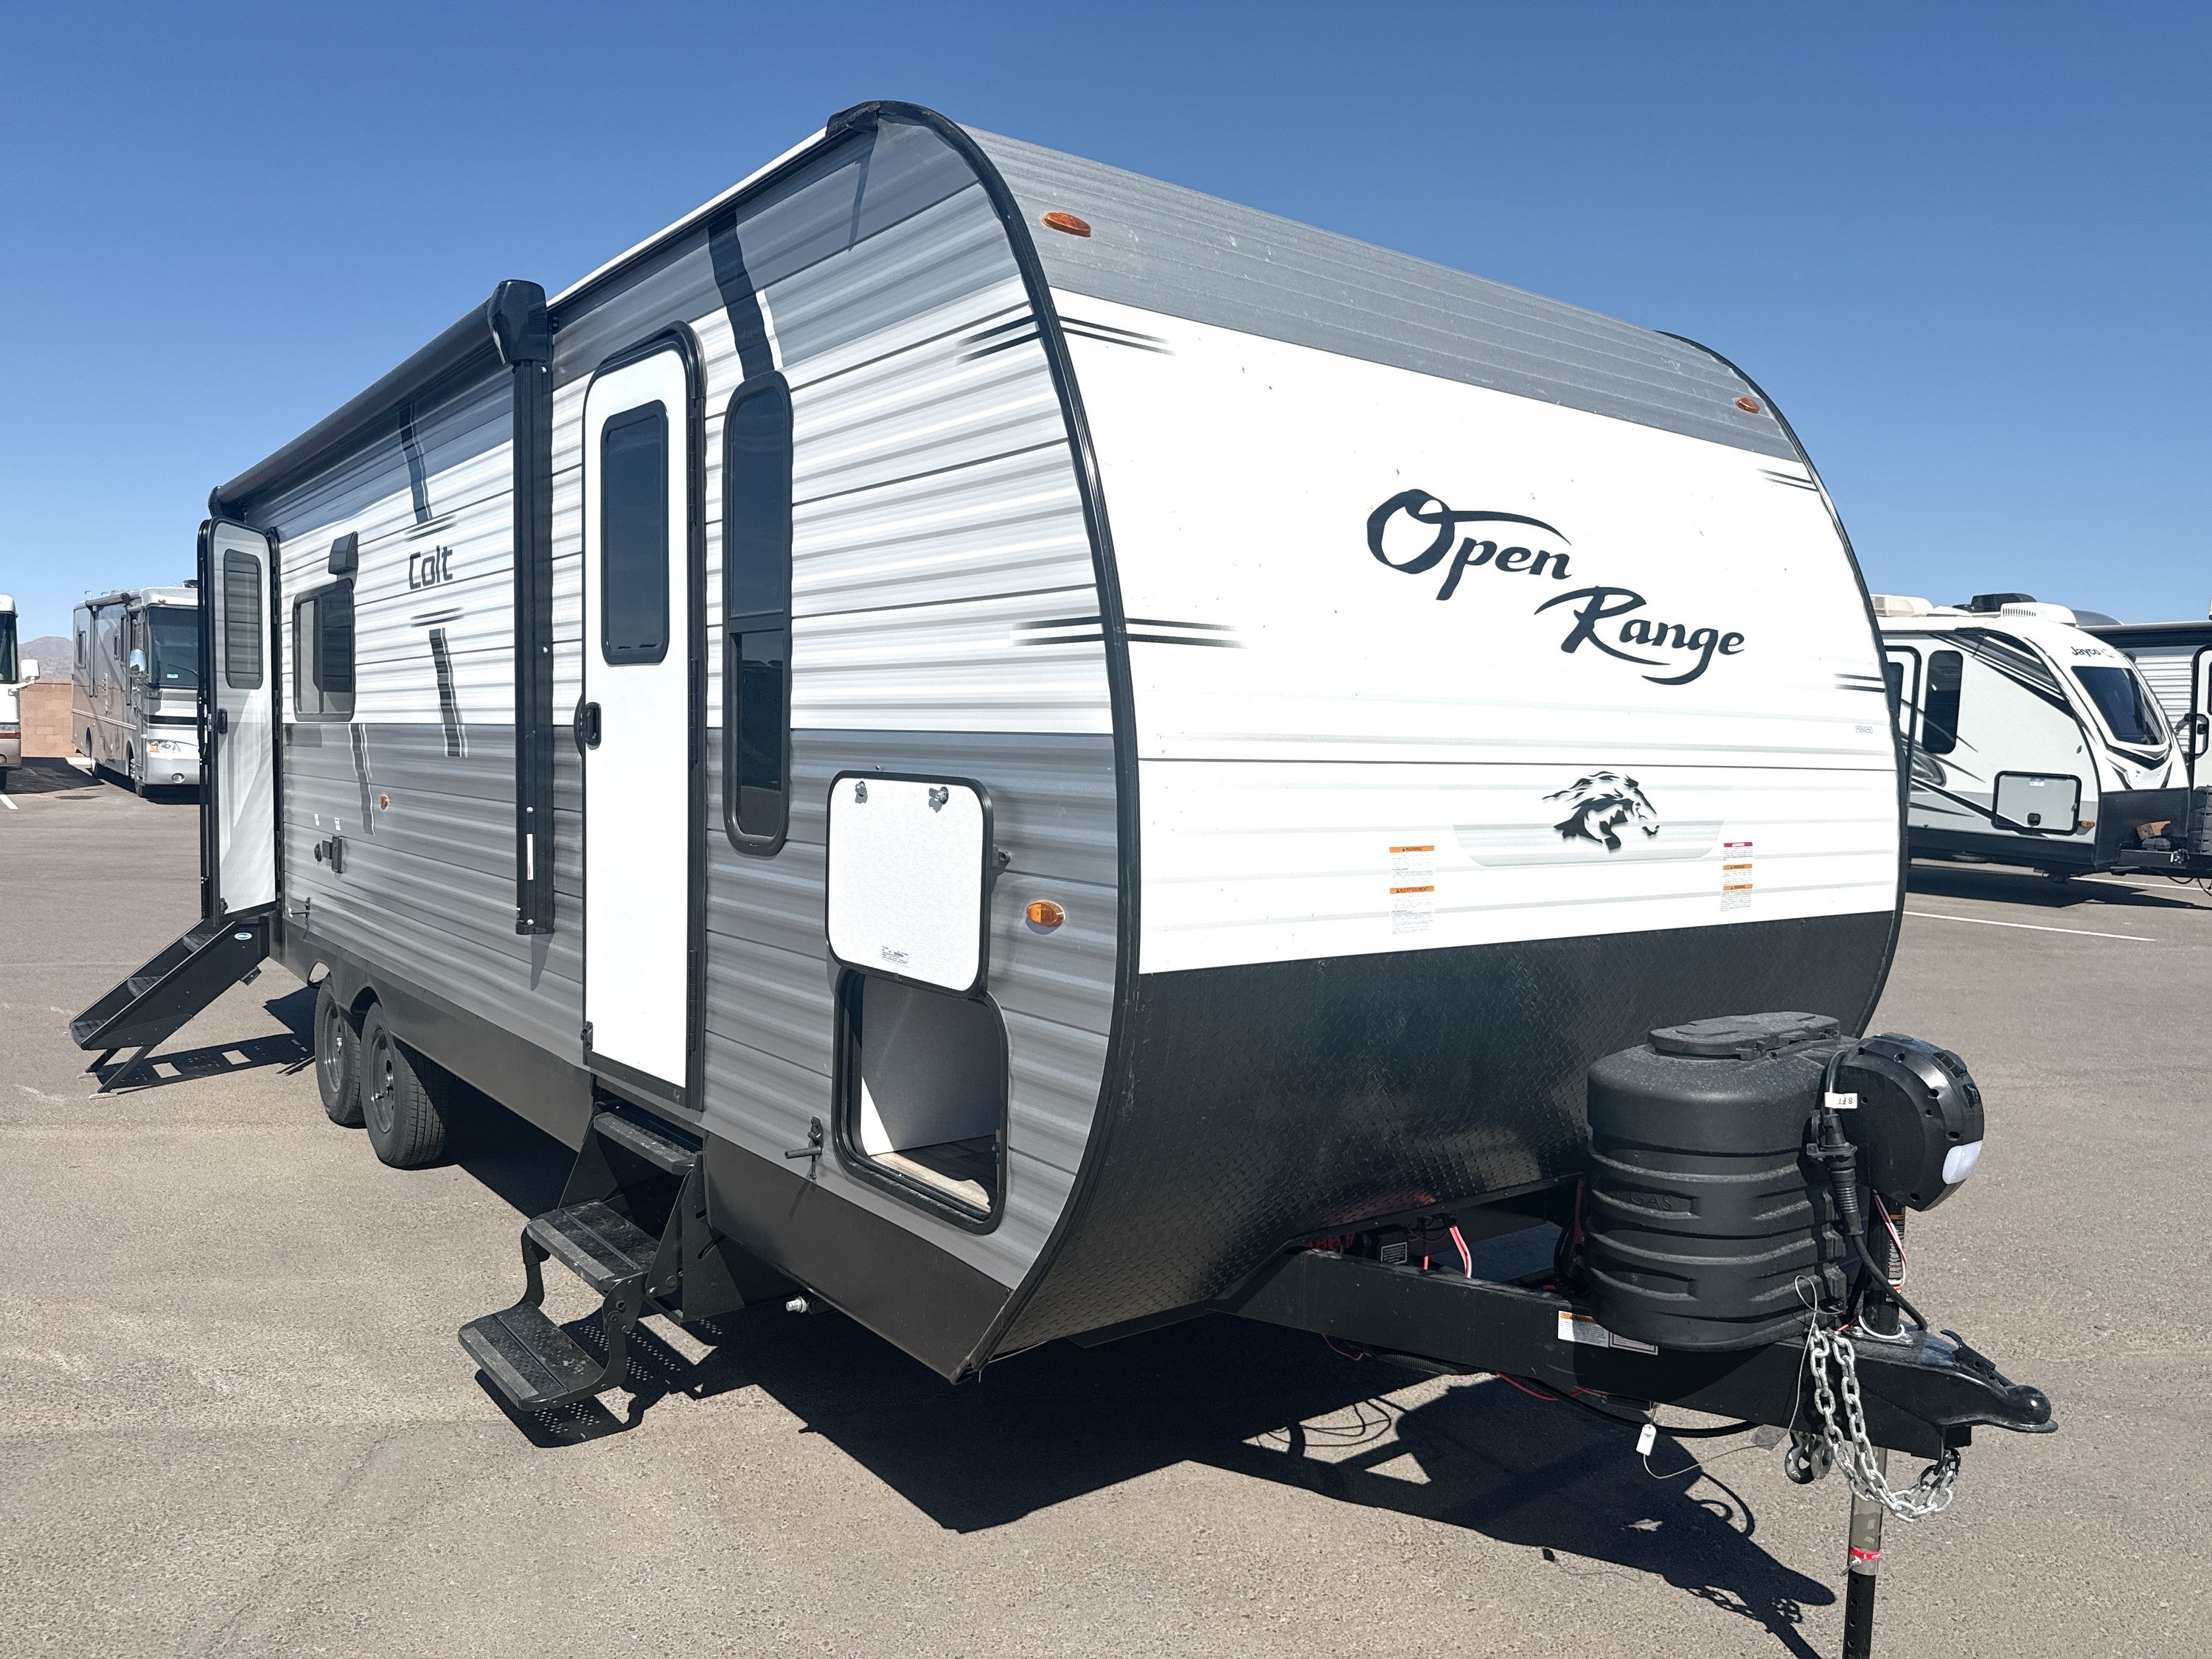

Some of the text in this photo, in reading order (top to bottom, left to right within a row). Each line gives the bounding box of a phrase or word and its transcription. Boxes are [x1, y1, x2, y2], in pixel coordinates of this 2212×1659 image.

[1366, 488, 1573, 601] Open
[408, 545, 453, 590] Colt
[1534, 585, 1745, 686] Range
[2070, 646, 2101, 657] Jayco
[1837, 1096, 1846, 1105] FT
[1630, 1191, 1672, 1211] GAS
